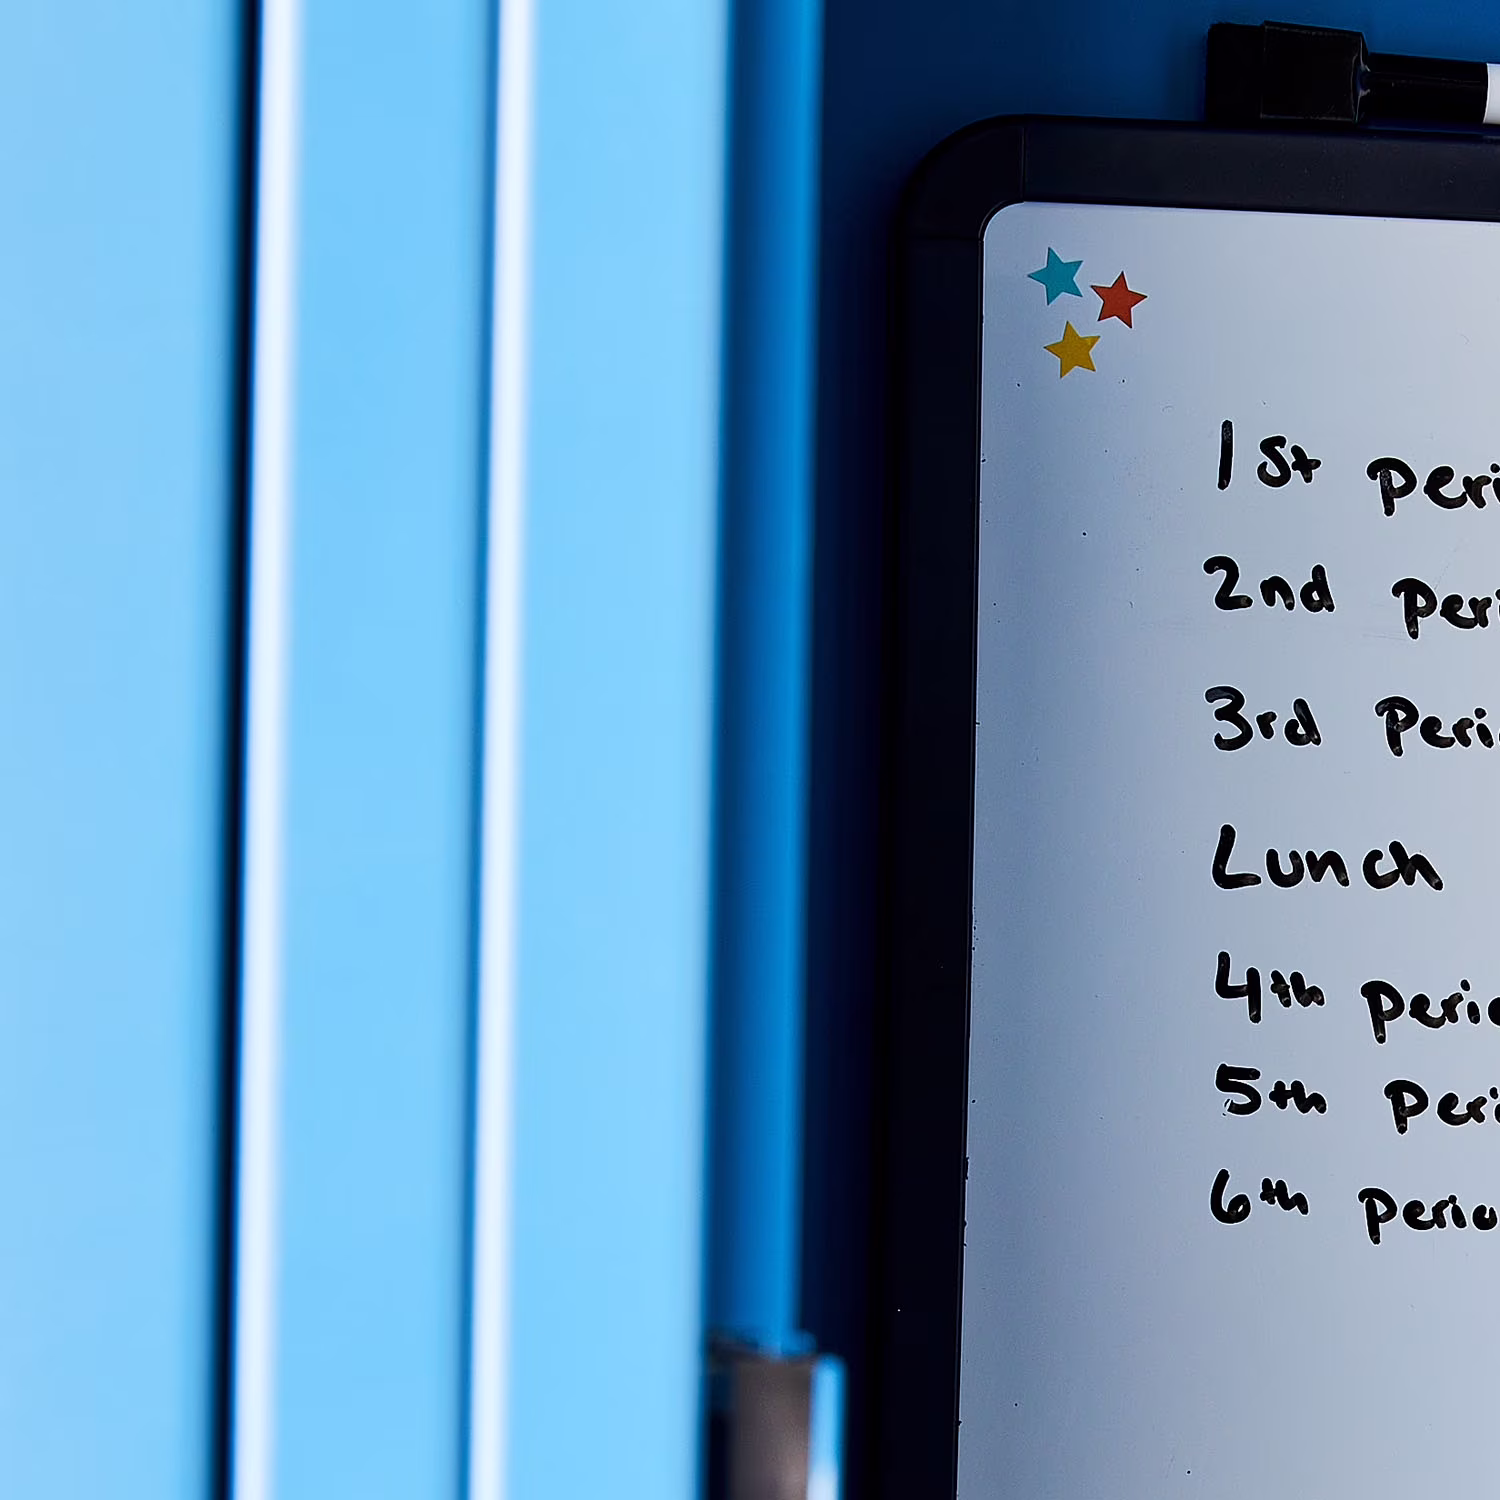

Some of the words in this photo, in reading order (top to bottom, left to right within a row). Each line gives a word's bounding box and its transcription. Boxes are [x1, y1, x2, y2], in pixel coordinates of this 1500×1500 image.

[1203, 555, 1336, 613] 2nd
[1204, 685, 1322, 752] 3rd
[1211, 824, 1444, 891] Lunch
[1215, 951, 1325, 1024] 4th
[1215, 1063, 1327, 1116] 5th
[1210, 1168, 1309, 1225] 6th
